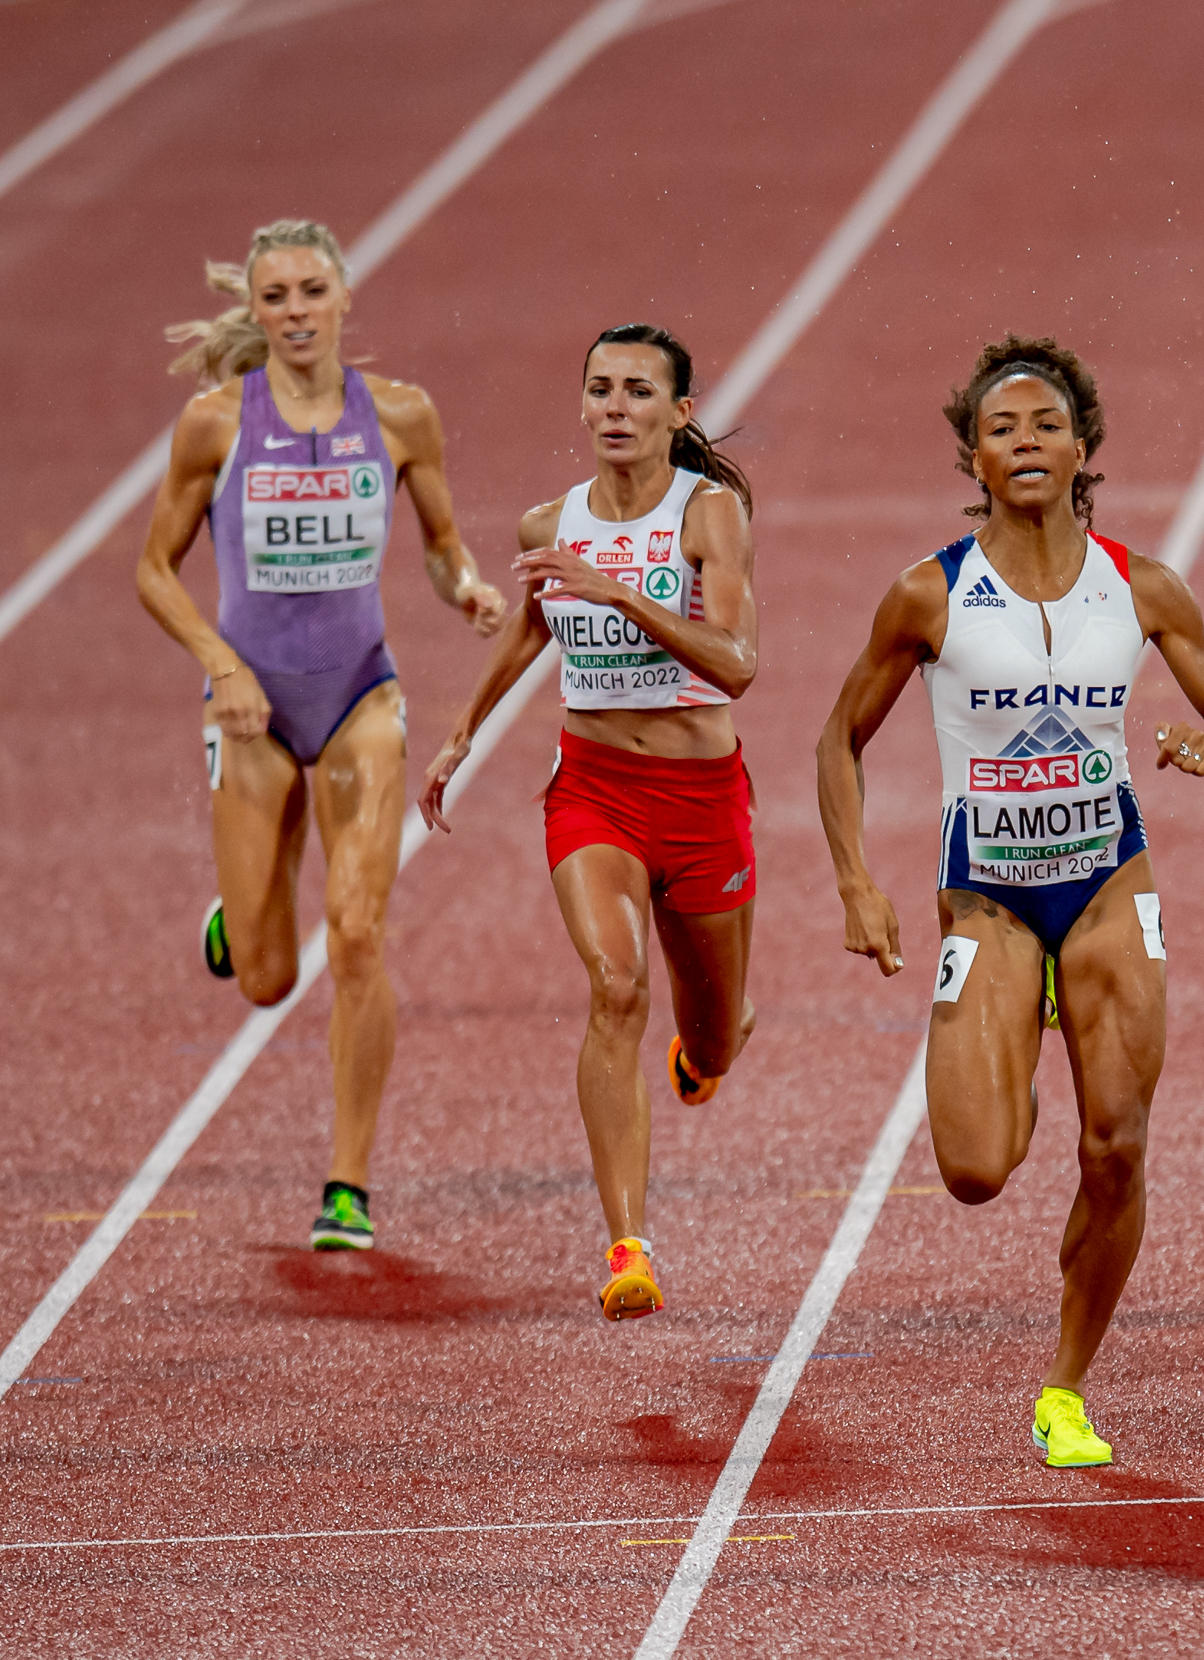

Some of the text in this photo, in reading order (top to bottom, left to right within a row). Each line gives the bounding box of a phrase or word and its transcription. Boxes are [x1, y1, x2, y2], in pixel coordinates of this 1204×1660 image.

[250, 473, 349, 499] SPAR
[265, 513, 366, 546] BELL
[598, 554, 632, 563] ORLEN
[256, 569, 331, 587] MUNICH
[962, 594, 1007, 608] adidas
[580, 656, 605, 667] RUN
[607, 654, 648, 667] CLEAN
[564, 666, 681, 690] MUNICH 2022
[969, 684, 1127, 710] FRANCE
[972, 759, 1078, 788] SPAR
[972, 795, 1116, 840] LAMOTE
[1012, 848, 1041, 860] RUN
[1044, 841, 1087, 858] CLEAN
[979, 860, 1061, 882] MUNICH
[939, 948, 957, 991] 6
